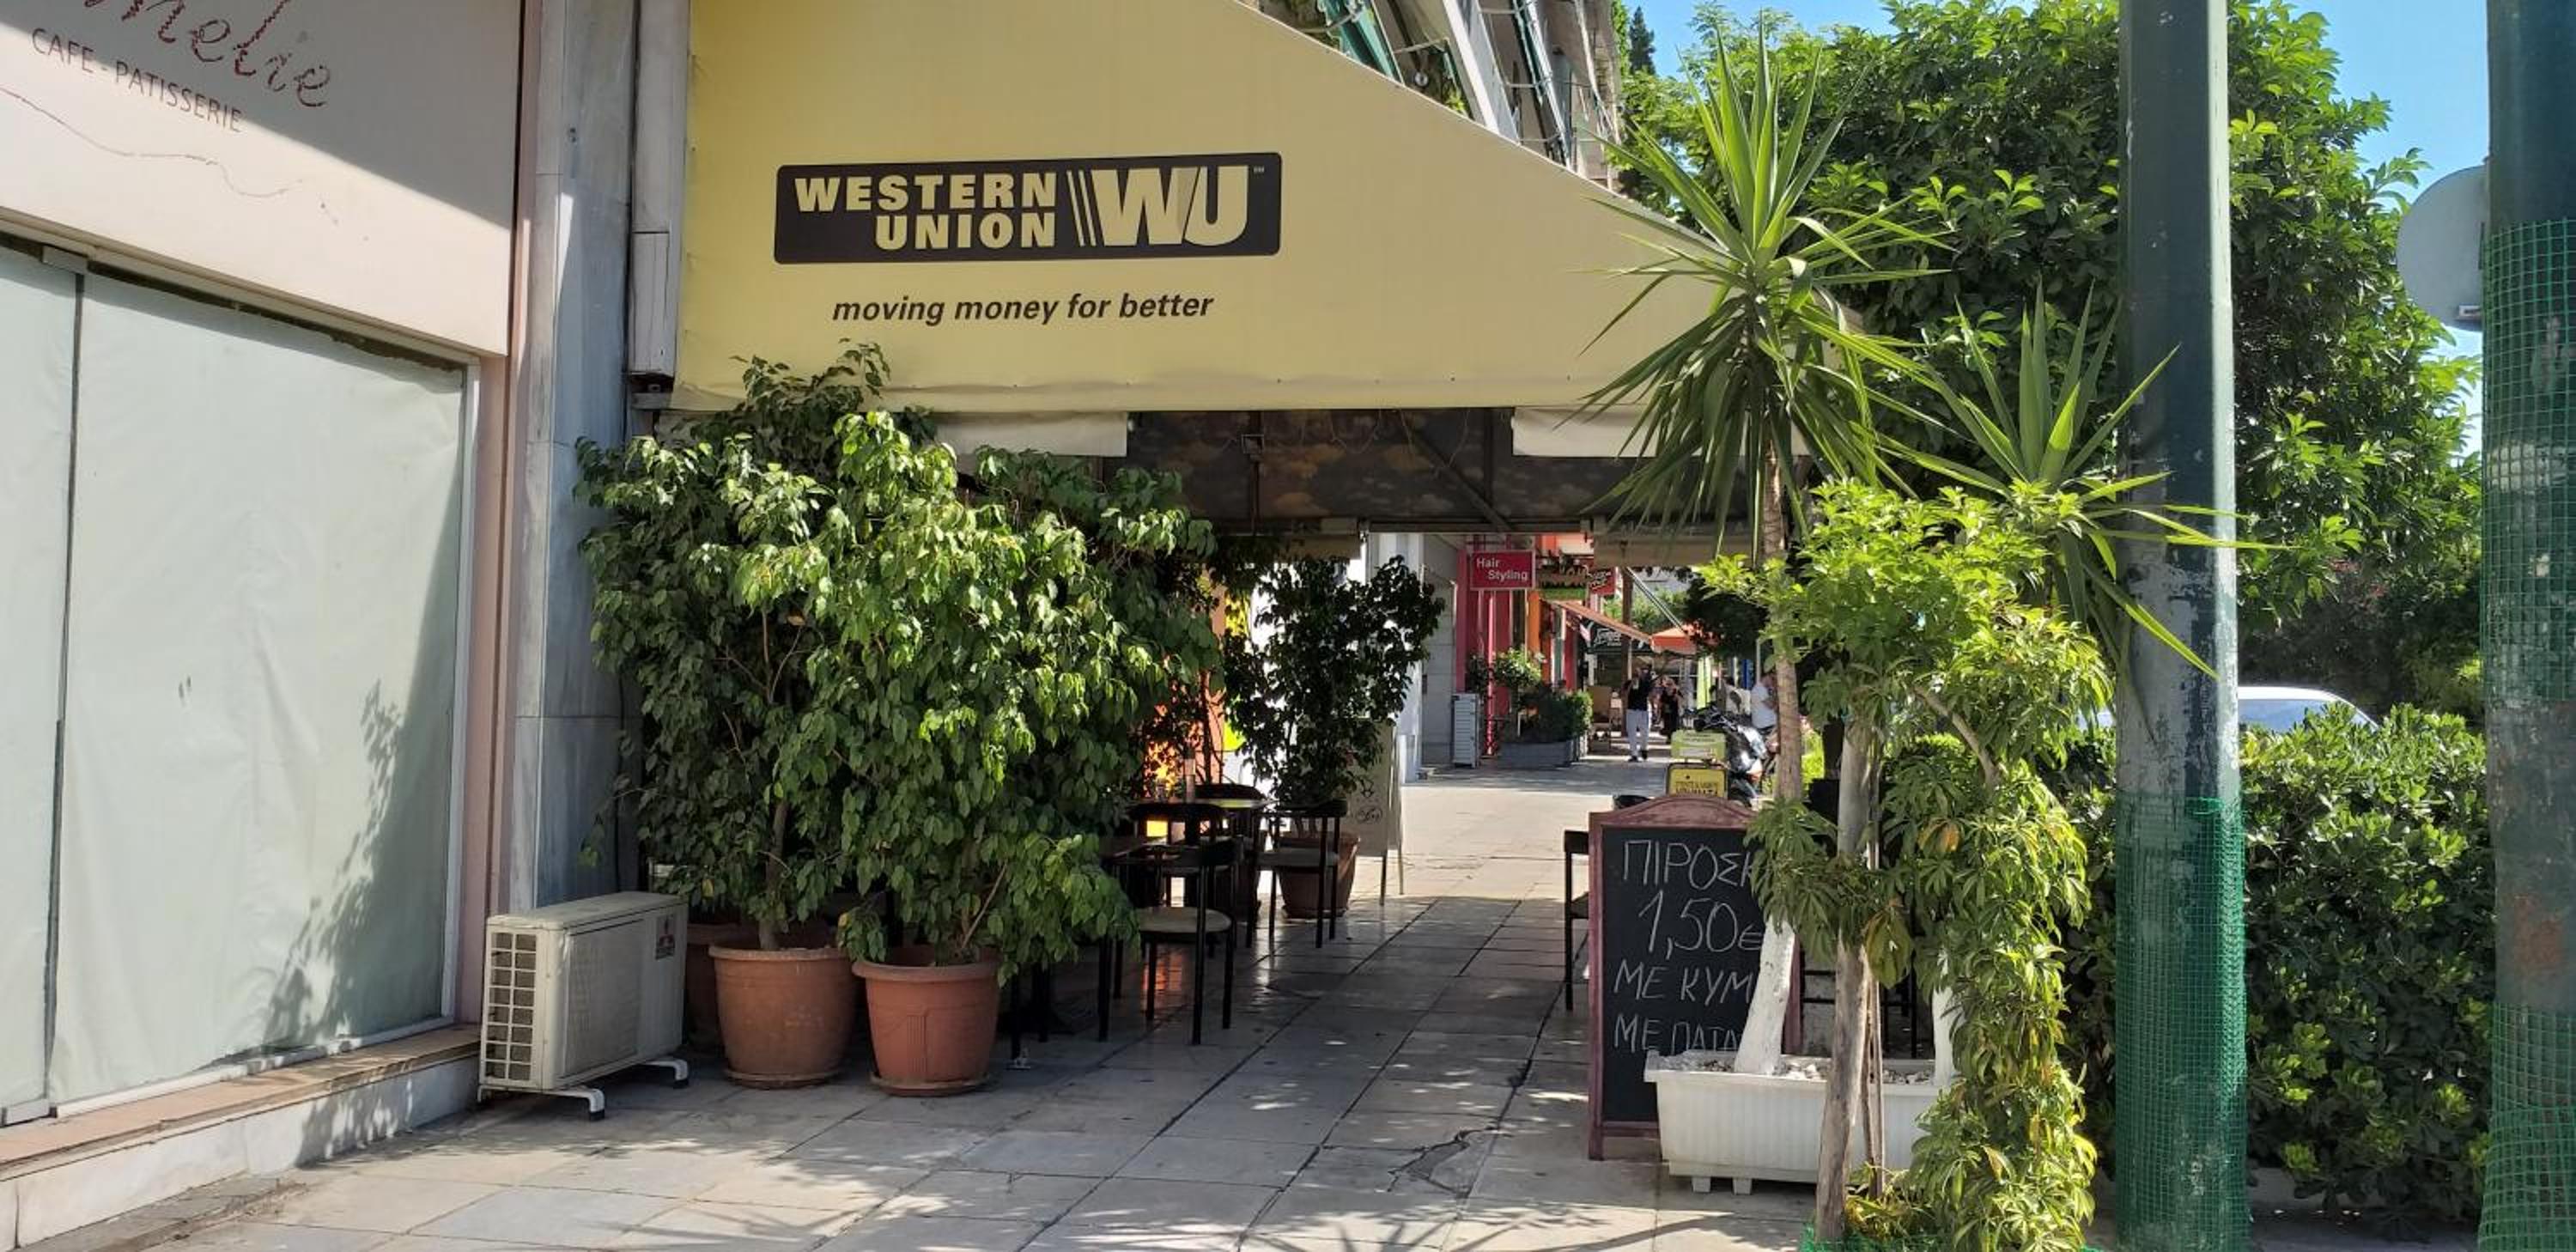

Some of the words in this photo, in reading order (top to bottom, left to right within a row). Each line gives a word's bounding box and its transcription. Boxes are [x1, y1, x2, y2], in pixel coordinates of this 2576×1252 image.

[31, 27, 94, 74] CAFE
[114, 60, 242, 132] PATISSERIE
[794, 172, 1057, 212] WESTERN
[1089, 165, 1249, 246] WU
[874, 211, 1056, 250] UNION
[832, 296, 945, 327] moving
[953, 297, 1060, 325] money
[1066, 293, 1111, 319] for
[1118, 293, 1215, 319] better
[1476, 558, 1500, 568] Hair
[1488, 569, 1528, 582] Styling
[1623, 839, 1754, 891] ΠΙΡΟΣΚ
[1613, 958, 1668, 1000] ΜΕ
[1680, 965, 1755, 1006] ΚΥΜ
[1613, 1012, 1662, 1054] ΜΕ
[1672, 1021, 1741, 1055] ΠΑΤΑ
